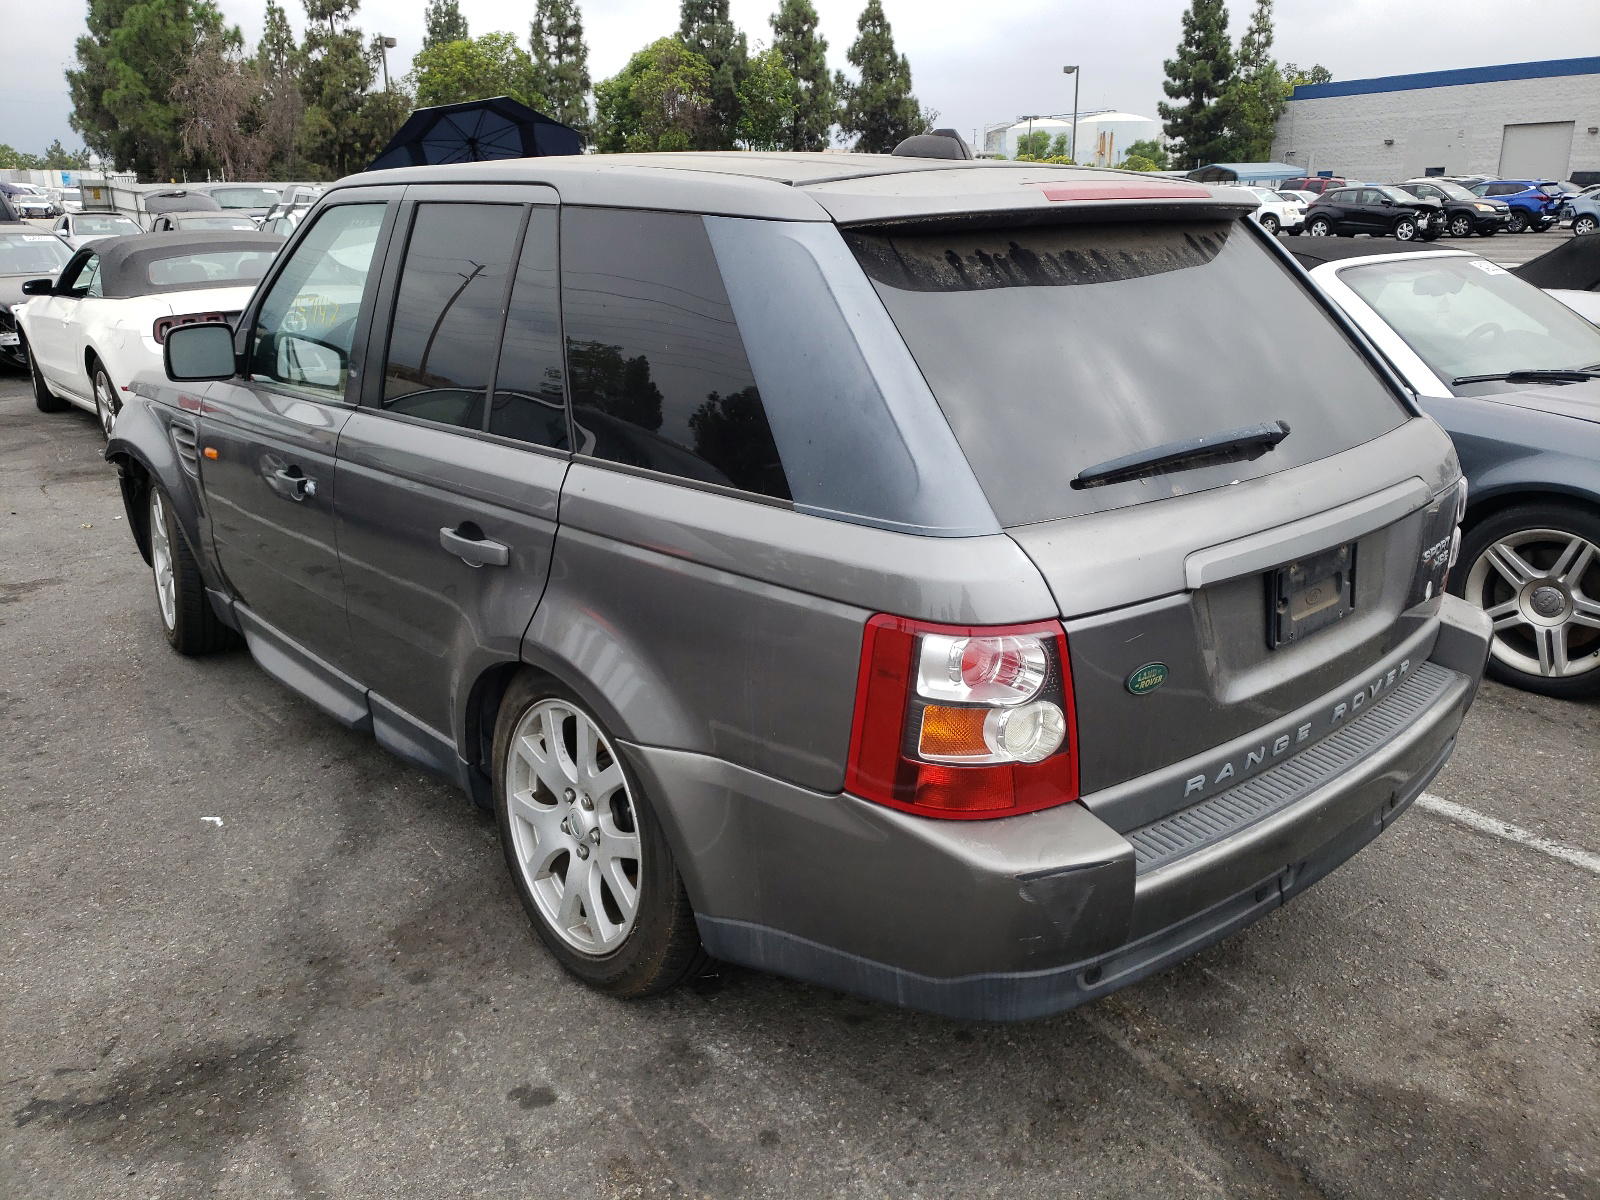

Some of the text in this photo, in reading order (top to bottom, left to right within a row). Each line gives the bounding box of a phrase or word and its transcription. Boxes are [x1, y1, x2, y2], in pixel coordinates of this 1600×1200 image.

[1422, 535, 1450, 561] SPORT
[1137, 669, 1158, 682] LAND
[1139, 675, 1163, 690] ROVER
[1184, 659, 1410, 798] RANGE ROVER
